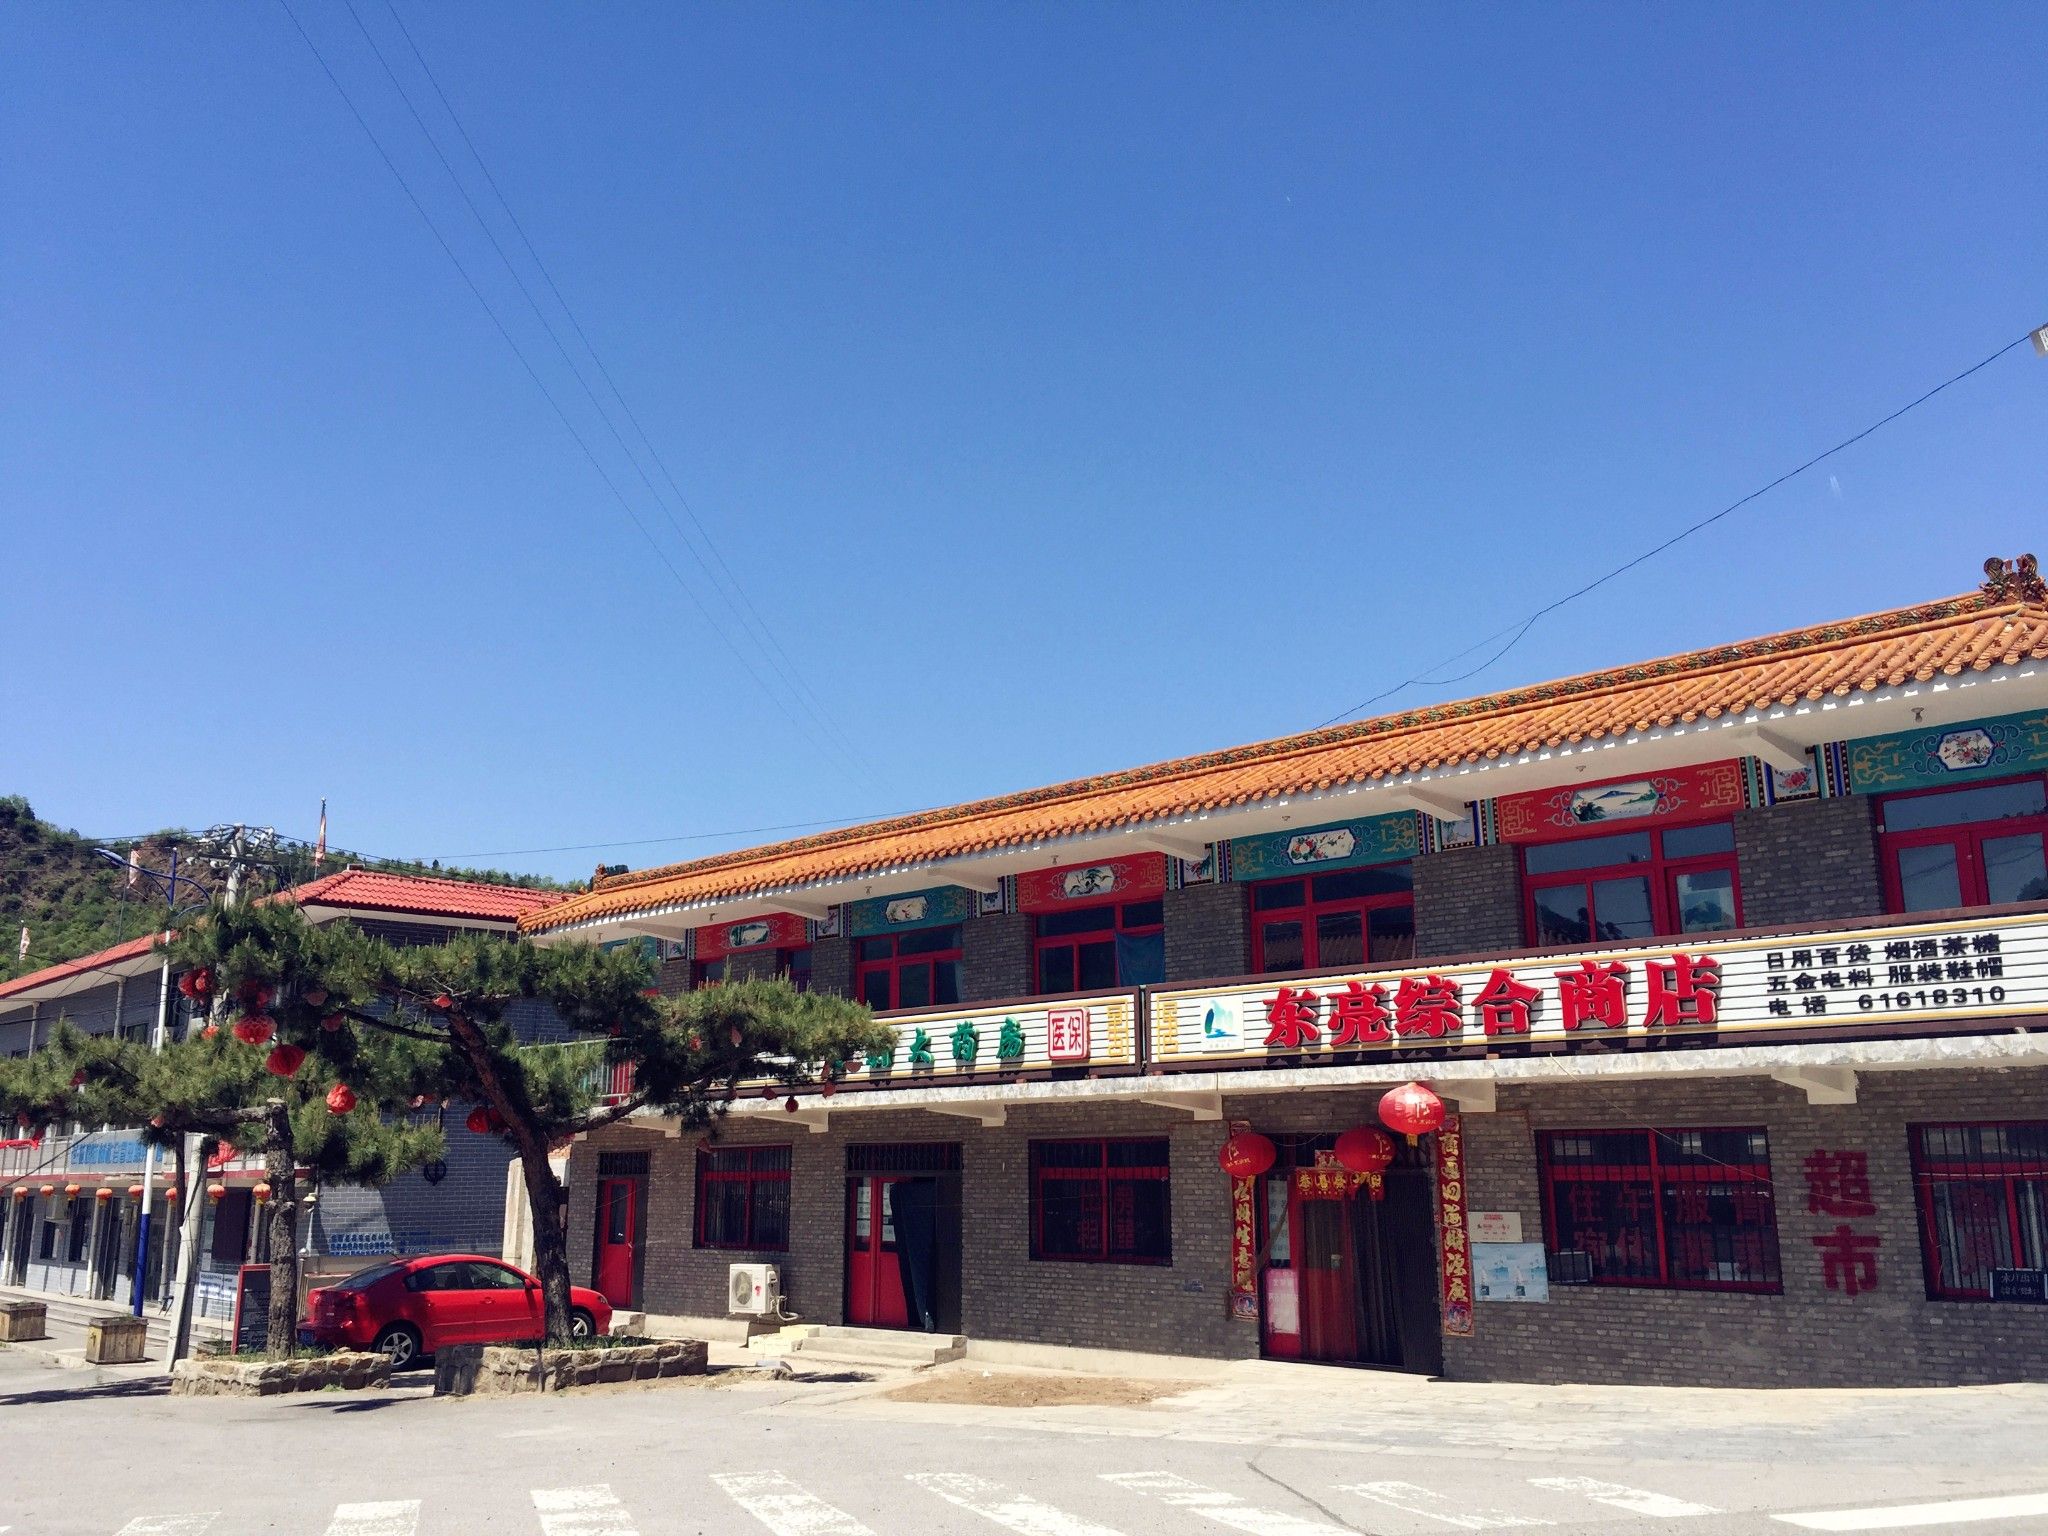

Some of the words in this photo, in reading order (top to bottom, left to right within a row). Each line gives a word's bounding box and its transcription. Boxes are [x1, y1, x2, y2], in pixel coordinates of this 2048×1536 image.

[1767, 944, 1872, 969] 日用百货
[1885, 933, 2002, 962] 烟酒茶糖
[1768, 968, 1874, 993] 五金电料
[1888, 957, 2004, 985] 服装鞋帽
[1263, 953, 1721, 1048] 东亮综合商店
[1769, 995, 1827, 1015] 电话
[1858, 985, 2006, 1010] 61618310
[1052, 1015, 1082, 1052] 医保
[1804, 1149, 1881, 1295] 超市
